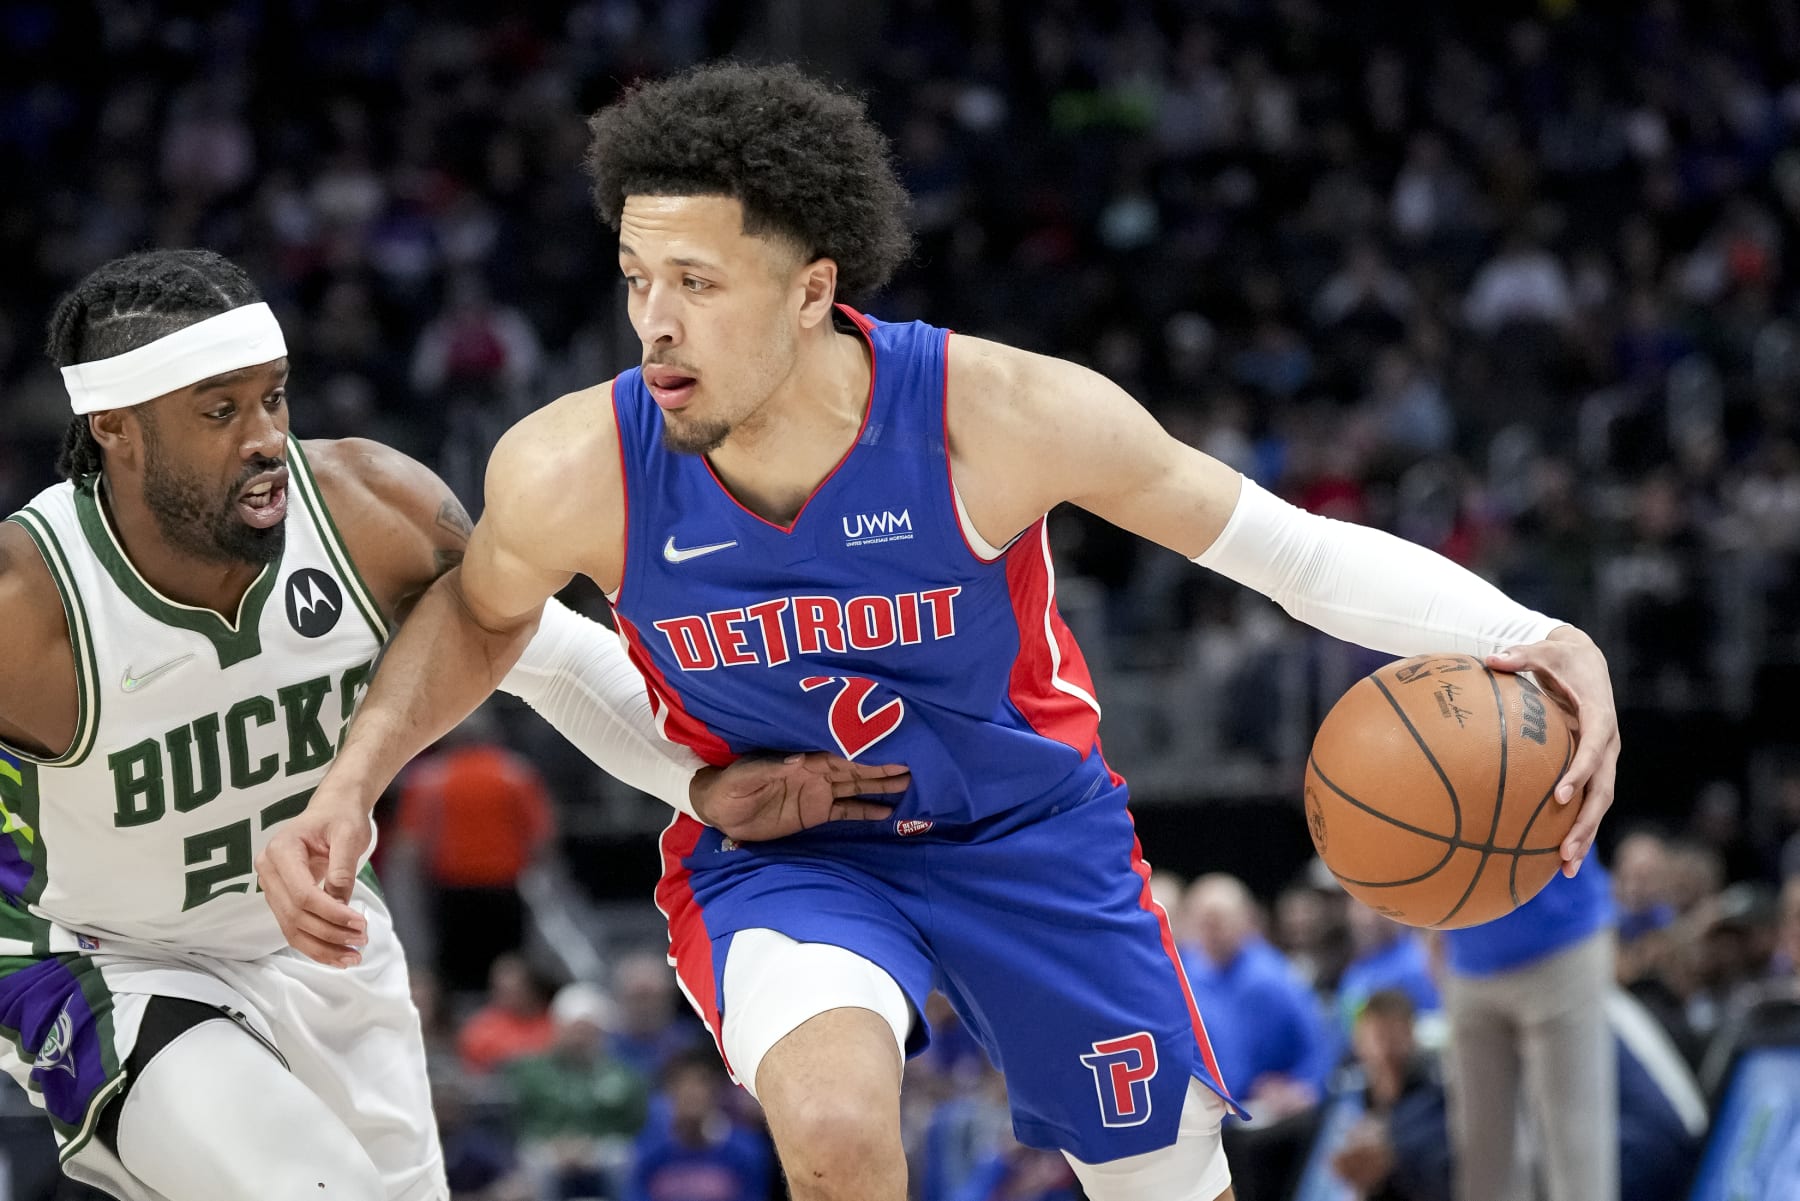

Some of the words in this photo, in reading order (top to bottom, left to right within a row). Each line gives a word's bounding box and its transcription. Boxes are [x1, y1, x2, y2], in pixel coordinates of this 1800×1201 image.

[842, 508, 913, 538] UWM
[653, 586, 962, 671] DETROIT
[799, 676, 904, 761] 2
[181, 787, 318, 912] 2
